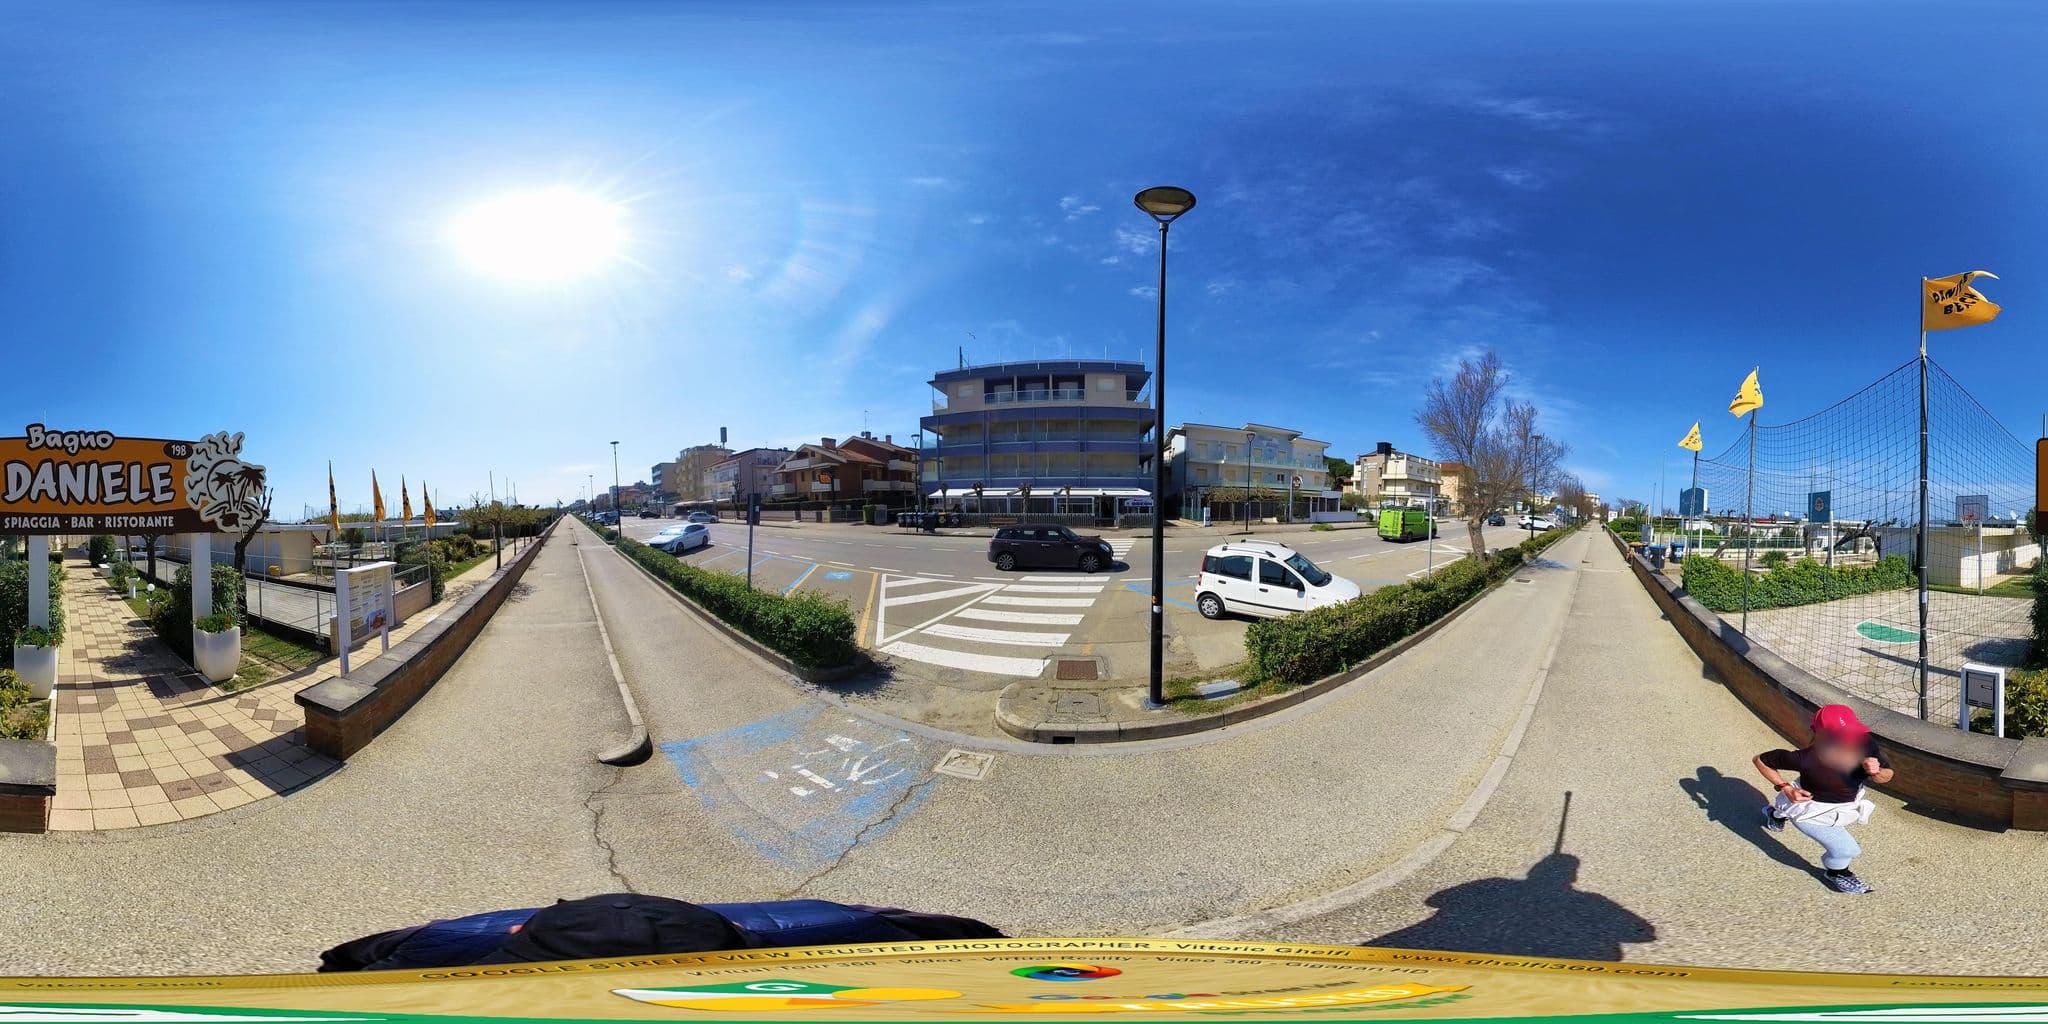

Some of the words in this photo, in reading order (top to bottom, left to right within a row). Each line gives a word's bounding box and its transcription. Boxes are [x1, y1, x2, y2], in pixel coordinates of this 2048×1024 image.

[28, 425, 114, 454] Bagno
[171, 445, 187, 456] 198
[4, 461, 176, 504] DANIELE
[4, 516, 61, 529] SPIAGGIA
[71, 516, 94, 528] BAR
[105, 516, 174, 528] RISTORANTE
